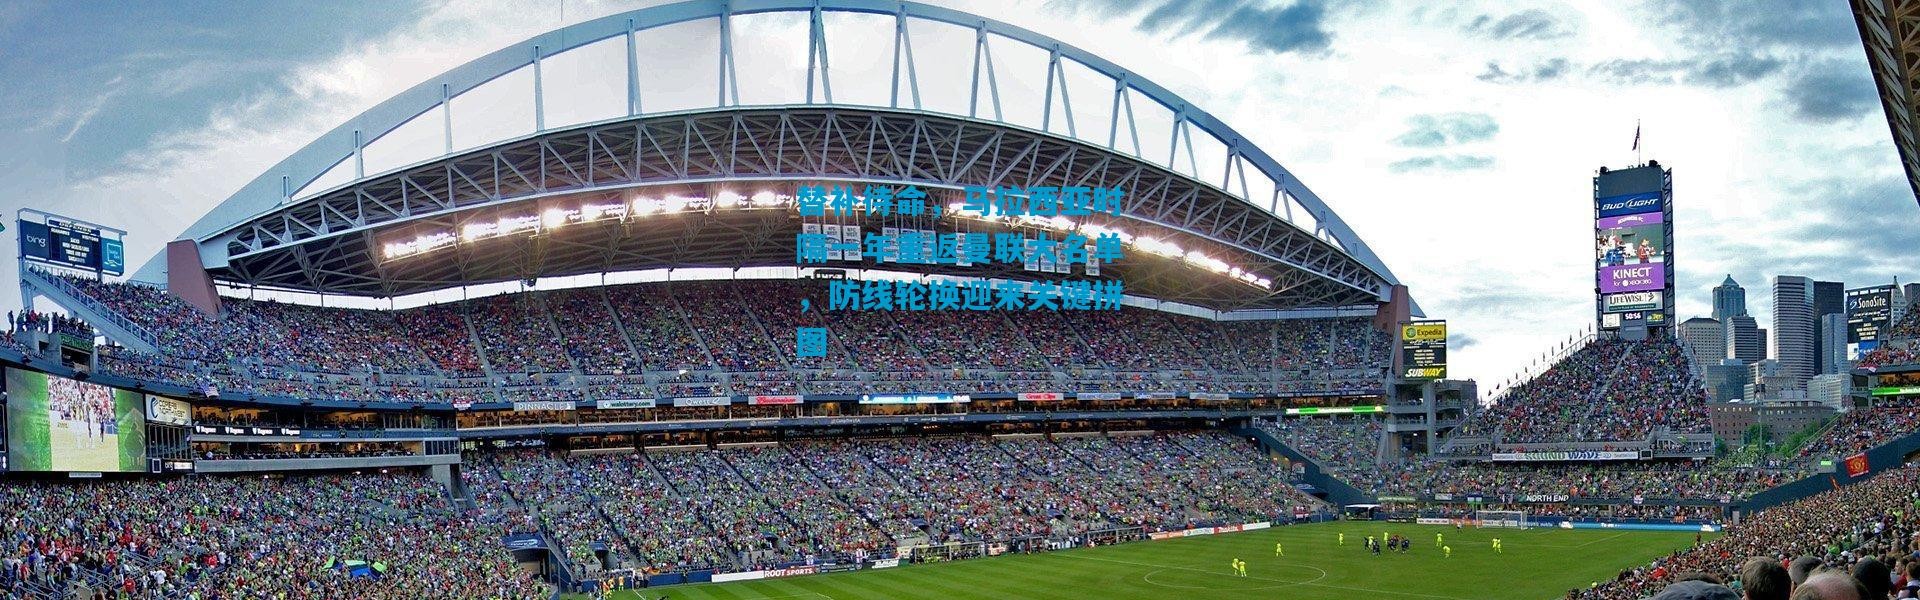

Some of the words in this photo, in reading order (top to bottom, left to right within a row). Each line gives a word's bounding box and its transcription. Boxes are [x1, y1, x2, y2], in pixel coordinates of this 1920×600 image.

[1628, 198, 1659, 207] LIGHT
[26, 234, 46, 248] bing
[1613, 267, 1653, 280] KINECT
[1858, 296, 1886, 308] SonoSite
[1405, 368, 1445, 378] SUBWAY
[685, 398, 710, 406] Qwest
[1527, 494, 1552, 502] NORTH
[765, 568, 787, 578] ROOT
[787, 568, 814, 576] SPORTS
